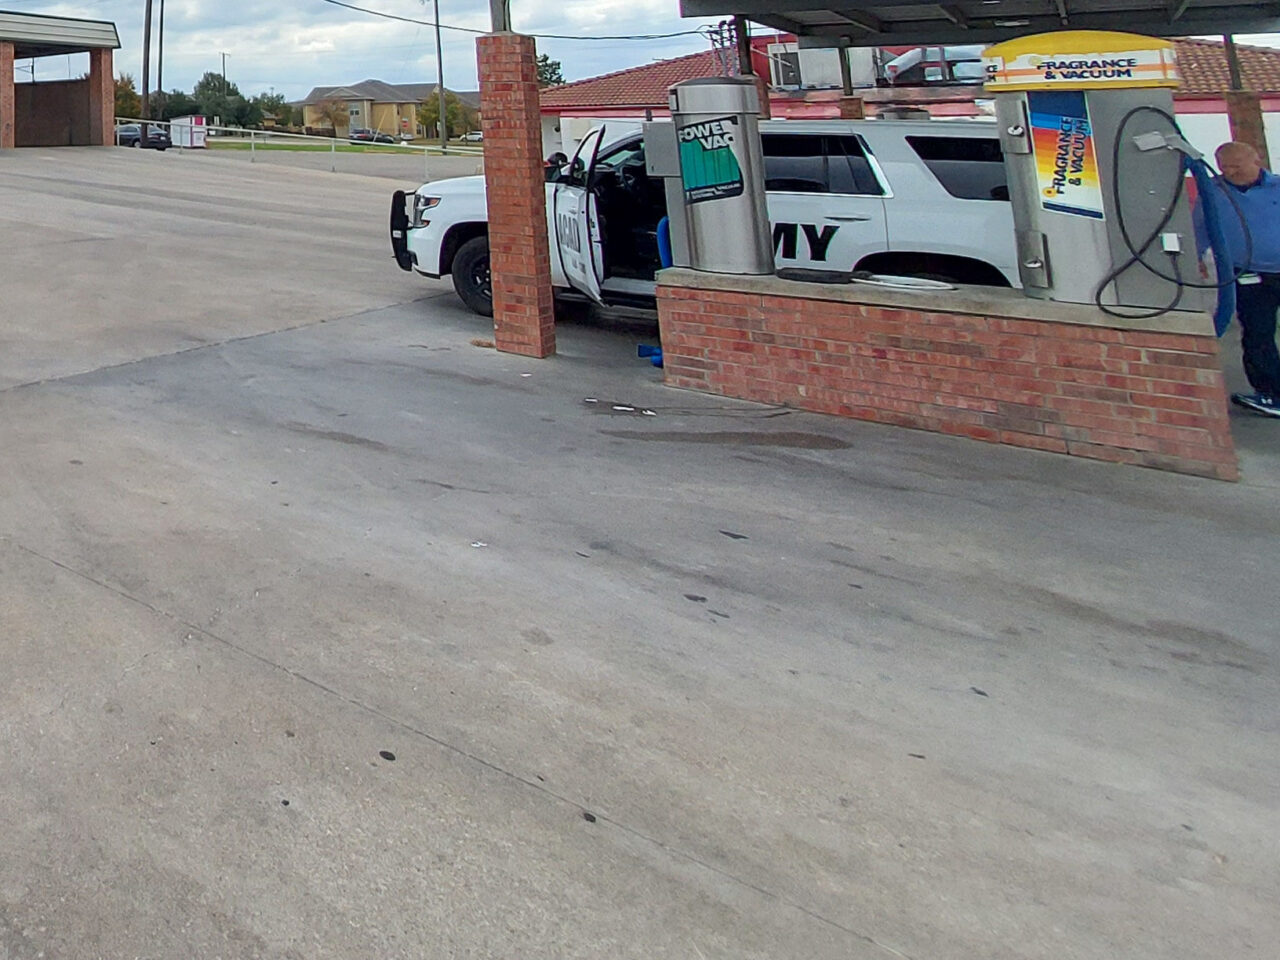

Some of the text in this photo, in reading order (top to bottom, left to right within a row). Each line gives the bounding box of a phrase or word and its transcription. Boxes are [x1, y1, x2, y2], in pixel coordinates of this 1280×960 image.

[1037, 58, 1136, 70] FRAGRANCE
[1044, 68, 1132, 80] & VACUUM
[1053, 117, 1073, 194] FRAGRANCE
[1068, 120, 1089, 186] & VACUUM
